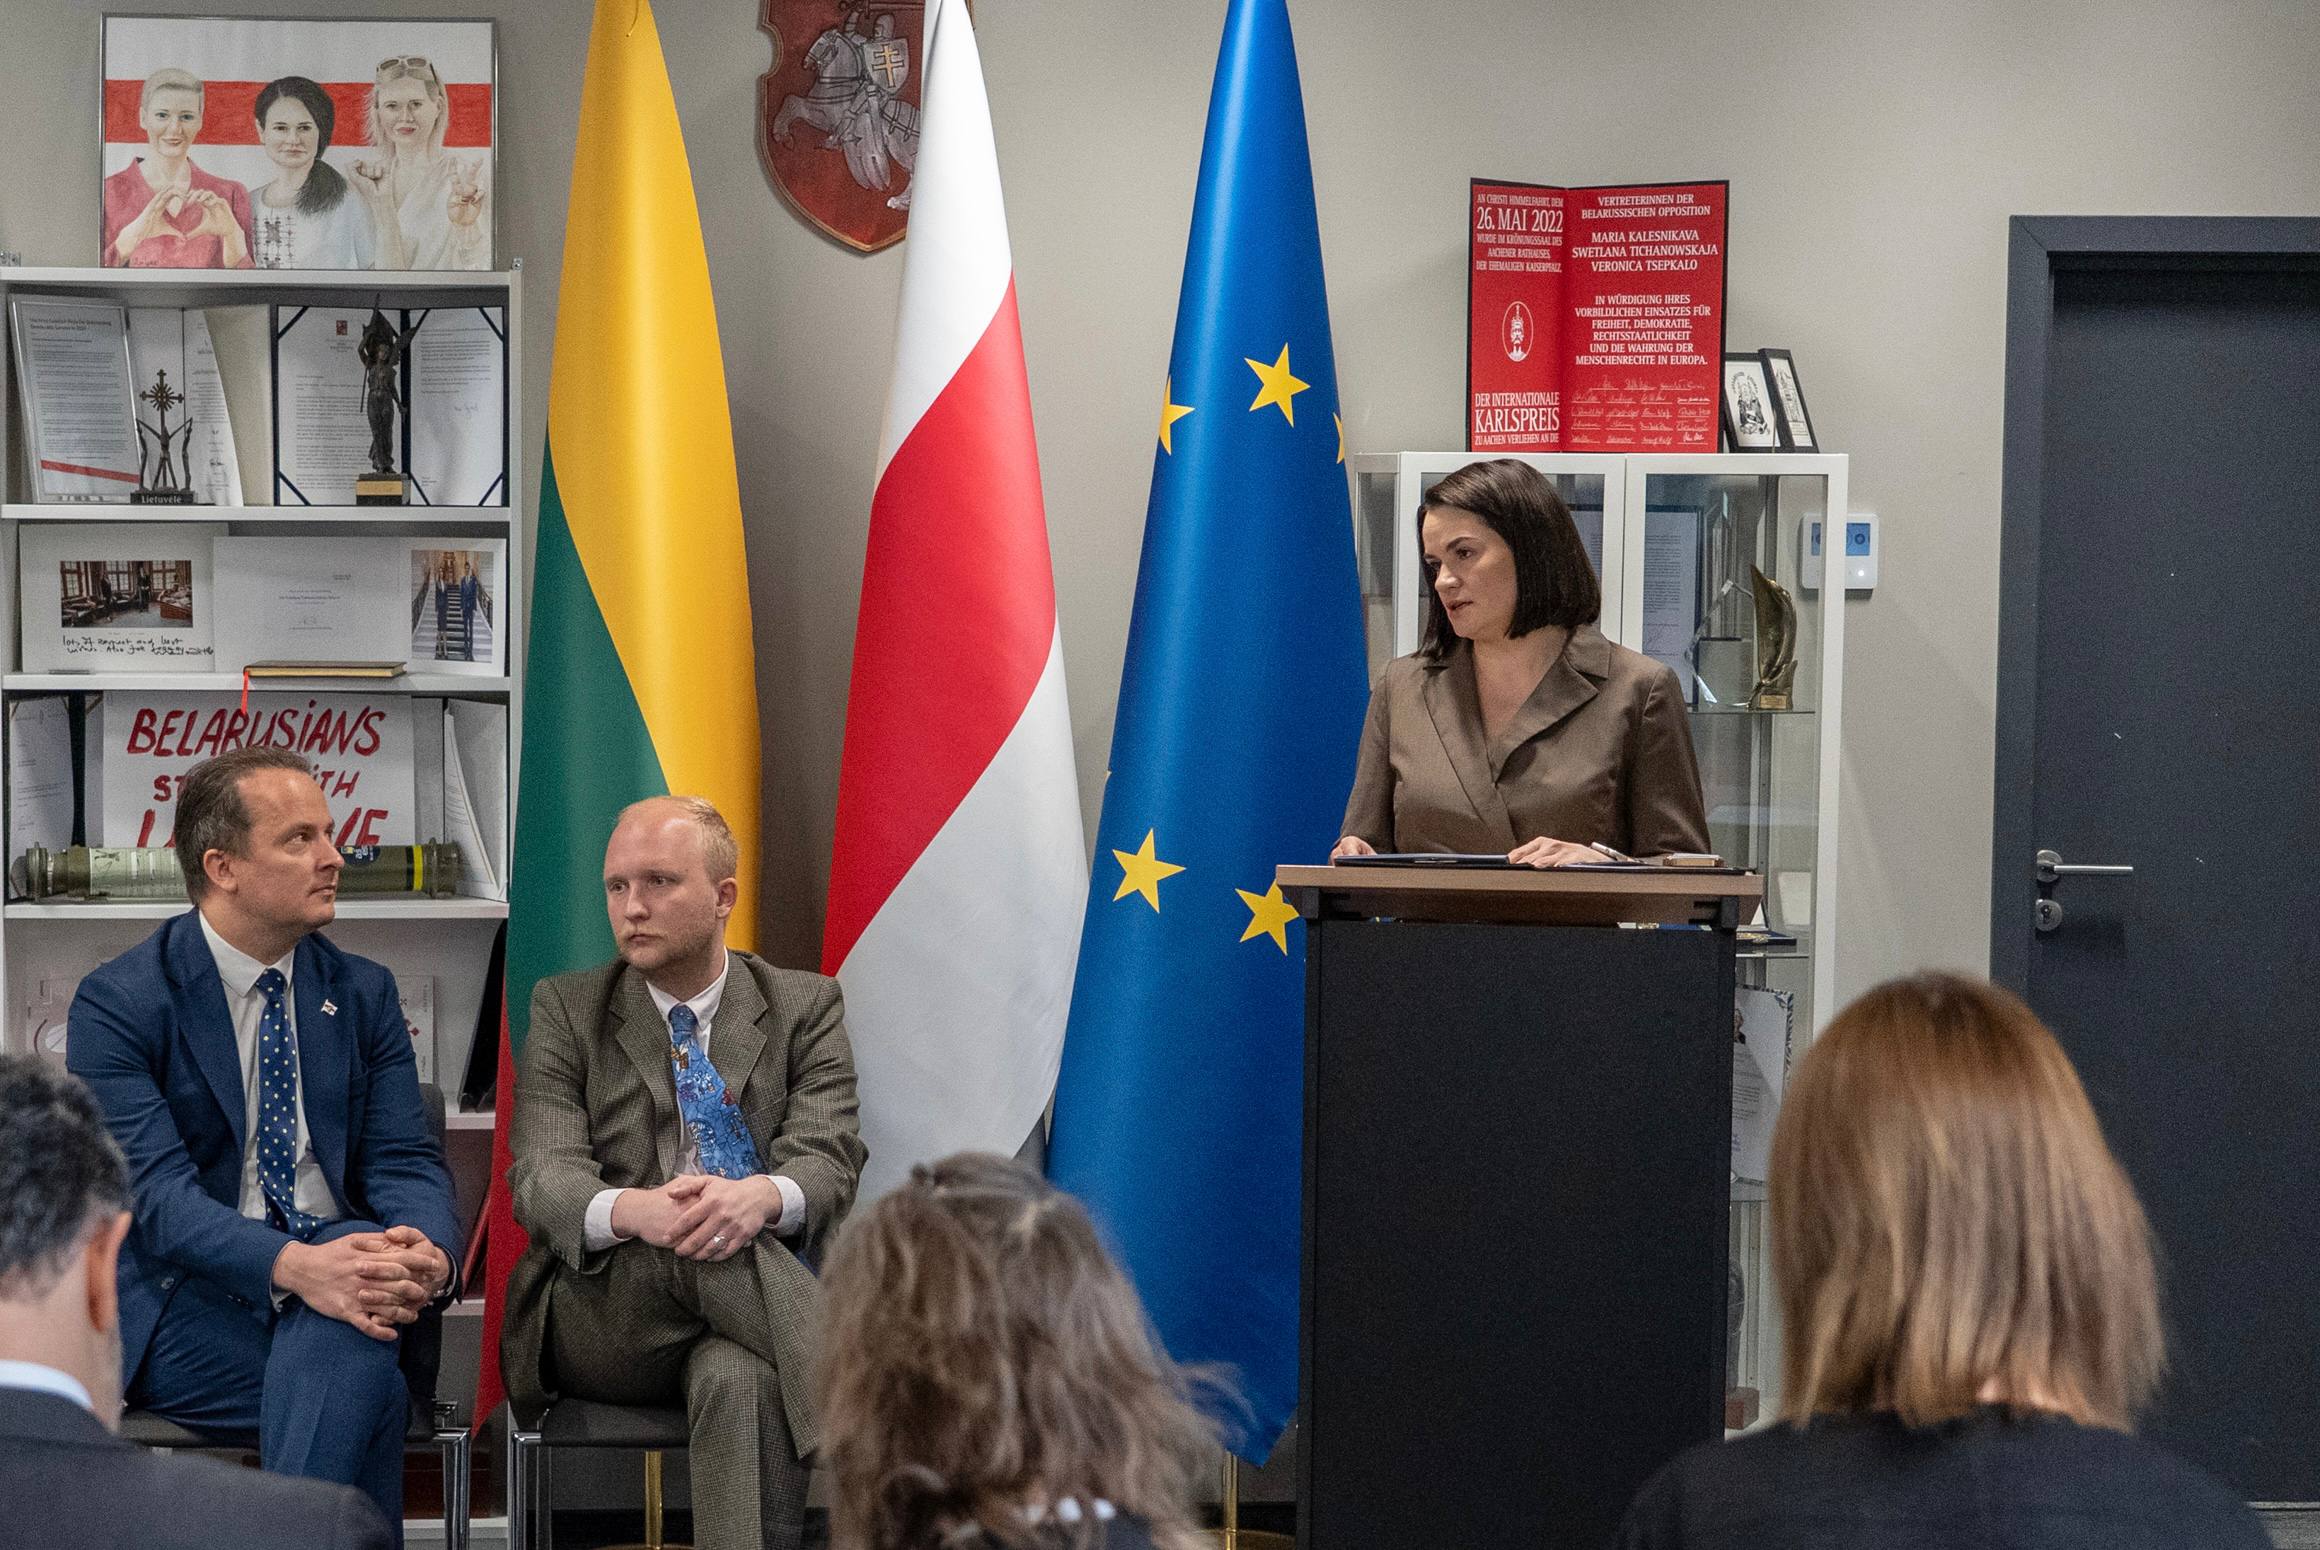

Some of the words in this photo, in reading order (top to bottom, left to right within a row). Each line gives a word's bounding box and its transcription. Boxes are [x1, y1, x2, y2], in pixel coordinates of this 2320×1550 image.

[1598, 195, 1674, 206] VERTRETERINNEN
[1677, 194, 1693, 204] DER
[1582, 208, 1656, 219] BELARUSSISCHEN
[1658, 206, 1710, 217] OPPOSITION
[1477, 206, 1495, 230] 26.
[1498, 208, 1527, 231] MAI
[1532, 210, 1563, 232] 2022
[1592, 232, 1625, 243] MARIA
[1629, 230, 1699, 242] KALESNIKAVA
[1572, 246, 1626, 258] SWETLANA
[1630, 244, 1718, 256] TICHANOWSKAJA
[1592, 261, 1643, 272] VERONICA
[1646, 259, 1697, 270] TSEPKALO
[1595, 295, 1604, 305] IN
[1608, 294, 1662, 305] WÜRDIGUNG
[1665, 295, 1690, 304] IHRES
[1575, 307, 1642, 317] VORBILDLICHEN
[1645, 307, 1690, 316] EINSATZES
[1693, 305, 1711, 316] FÜR
[1592, 320, 1631, 329] FREIHEIT,
[1634, 319, 1693, 329] DEMOKRATIE,
[1593, 331, 1691, 341] RECHTSSTAATLICHKEIT
[1590, 343, 1608, 353] UND
[1611, 343, 1625, 352] DIE
[1628, 343, 1673, 352] WAHRUNG
[1676, 343, 1693, 352] DER
[1576, 355, 1655, 365] MENSCHENRECHTE
[1658, 355, 1667, 365] IN
[1671, 355, 1707, 365] EUROPA.
[1475, 393, 1490, 407] DER
[1492, 392, 1560, 406] INTERNATIONALE
[1475, 408, 1560, 433] KARLSPREIS
